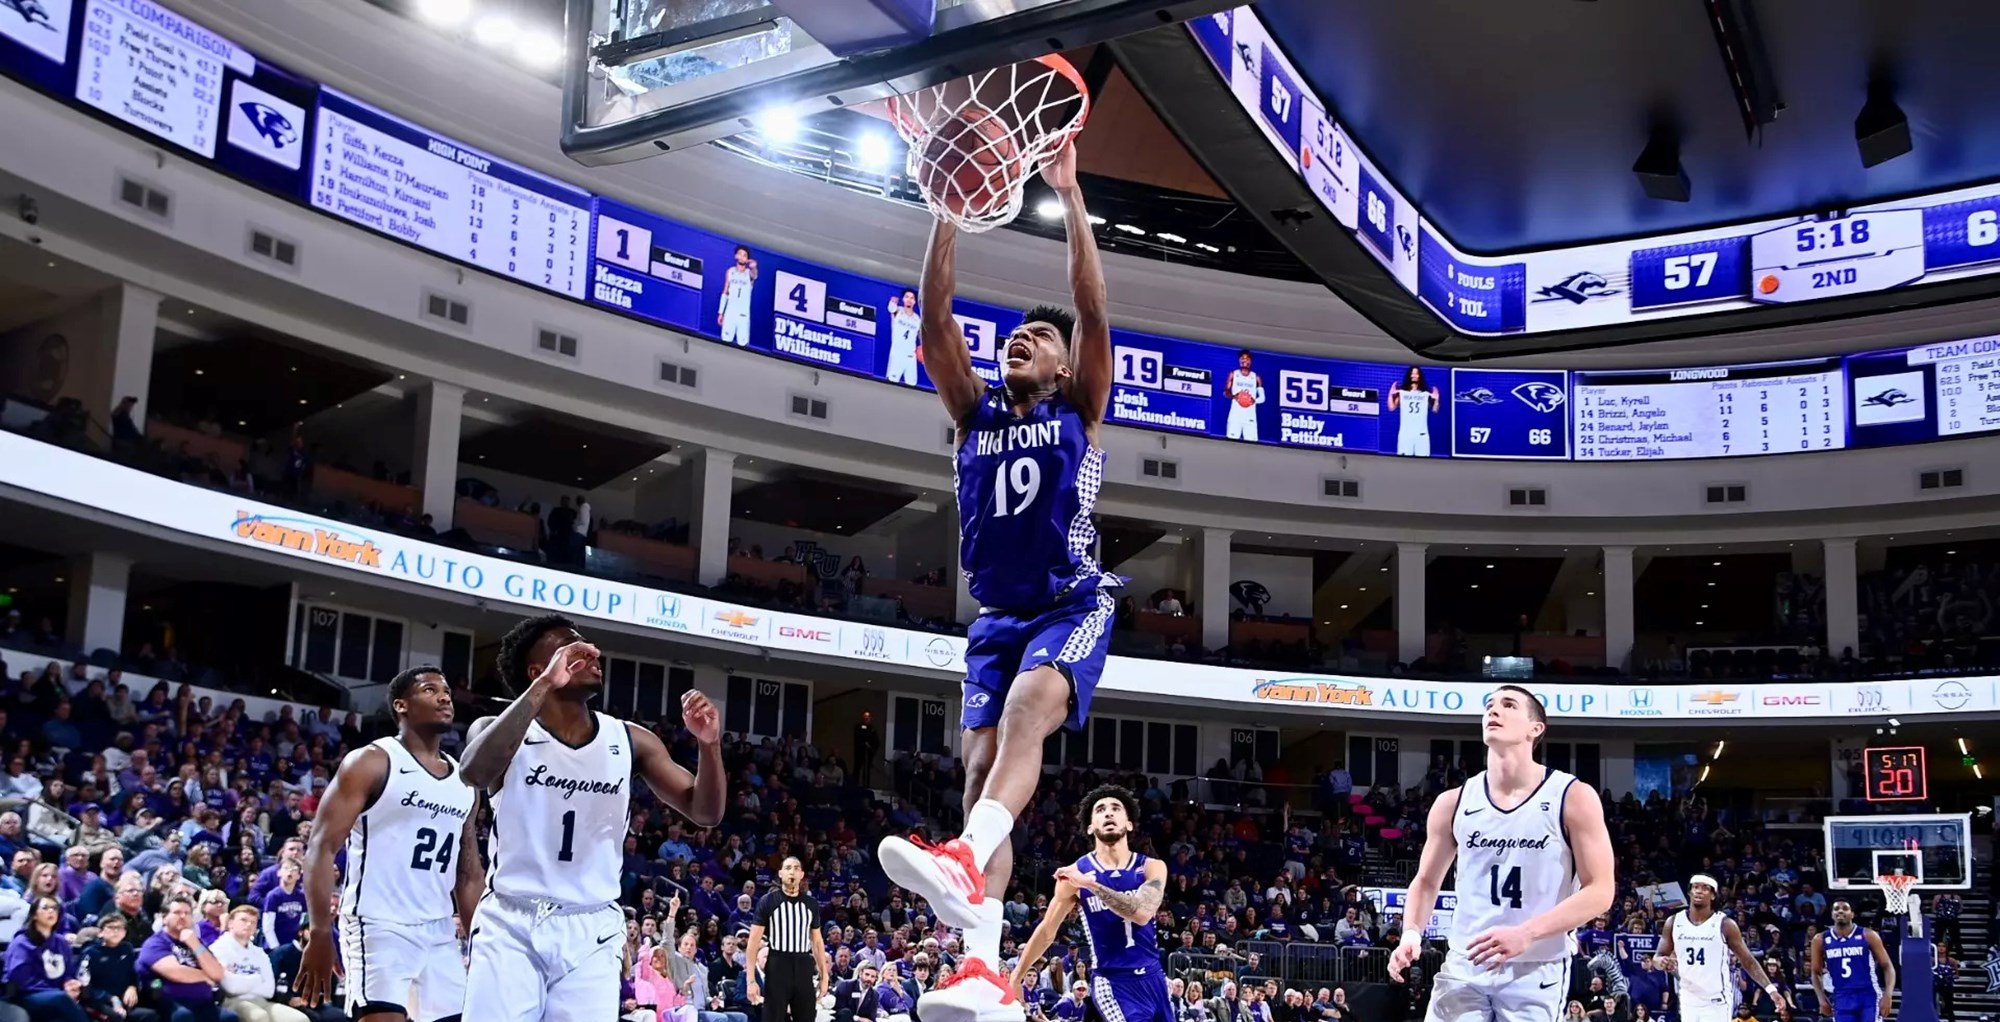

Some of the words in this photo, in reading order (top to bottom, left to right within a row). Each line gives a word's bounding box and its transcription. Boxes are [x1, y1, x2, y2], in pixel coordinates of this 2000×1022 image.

[130, 0, 233, 60] COMPARISON
[1271, 75, 1292, 124] 57
[428, 138, 456, 161] HIGH
[457, 150, 491, 173] POINT
[472, 184, 486, 197] 18
[470, 200, 483, 213] 11
[1367, 190, 1386, 232] 66
[316, 191, 332, 206] 55
[388, 218, 422, 242] Bobby
[469, 215, 483, 229] 13
[1797, 219, 1869, 252] 5:18
[1967, 210, 2000, 247] 6
[616, 228, 630, 261] 1
[664, 252, 690, 268] Guard
[595, 264, 643, 294] Kezza
[671, 270, 683, 281] SR
[1664, 251, 1719, 290] 57
[1812, 268, 1857, 289] 2ND
[1457, 272, 1495, 290] FOULS
[594, 282, 632, 308] Giffa
[789, 283, 808, 313] 4
[839, 302, 864, 316] Guard
[1459, 297, 1488, 318] TOL
[845, 318, 857, 328] SR
[775, 317, 852, 350] D'Maurian
[963, 323, 980, 352] 5
[775, 334, 840, 364] Williams
[1926, 344, 1968, 359] TEAM
[1122, 354, 1158, 384] 19
[1172, 368, 1205, 380] Forward
[1670, 368, 1728, 380] LONGWOOD
[1181, 382, 1192, 391] FR
[1285, 376, 1323, 405] 55
[1341, 388, 1366, 398] Guard
[1941, 386, 1962, 396] 10.0
[1114, 389, 1148, 407] Josh
[1718, 393, 1732, 402] 14
[1949, 398, 1957, 407] 5
[1114, 403, 1206, 430] Ibukunoluwa
[1348, 404, 1359, 412] SR
[1580, 409, 1593, 418] 14
[1719, 405, 1733, 415] 11
[1760, 403, 1768, 412] 6
[1822, 398, 1830, 408] 3
[1281, 413, 1325, 434] Bobby
[1580, 422, 1594, 431] 24
[1722, 419, 1730, 428] 2
[1948, 420, 1961, 430] 10
[1008, 420, 1062, 450] POINT
[1281, 428, 1343, 447] Pettiford
[1470, 427, 1491, 443] 57
[1528, 428, 1551, 445] 66
[1580, 435, 1594, 444] 25
[1722, 432, 1730, 441] 6
[1823, 425, 1831, 434] 3
[1580, 448, 1594, 457] 34
[1722, 444, 1730, 454] 7
[1823, 438, 1831, 447] 2
[992, 456, 1041, 517] 19
[236, 510, 314, 553] Vann
[314, 528, 383, 568] York
[391, 550, 484, 589] AUTO
[504, 574, 622, 614] GROUP
[313, 609, 337, 627] 107
[646, 616, 688, 631] HONDA
[711, 628, 759, 642] CHEVROLET
[779, 626, 832, 643] GMC
[854, 649, 891, 660] BUICK
[924, 647, 957, 657] NISSAN
[758, 682, 779, 697] 107
[1255, 678, 1317, 702] Vann
[1317, 683, 1374, 706] York
[1382, 688, 1463, 710] AUTO
[924, 702, 945, 716] 106
[1763, 696, 1821, 706] GMC
[1233, 732, 1253, 744] 106
[1377, 740, 1397, 752] 105
[1881, 753, 1917, 768] 5:17
[525, 765, 624, 800] Longwood
[1879, 768, 1913, 794] 20
[401, 790, 468, 819] Longwood
[558, 810, 575, 862] 1
[1466, 830, 1550, 856] Longwood
[410, 827, 454, 873] 24
[1490, 864, 1522, 909] 14
[1441, 897, 1457, 908] 66
[1628, 938, 1653, 948] THE
[1826, 948, 1842, 959] HIGH
[1842, 946, 1863, 957] POINT
[1686, 947, 1705, 966] 34
[1841, 957, 1852, 978] 5
